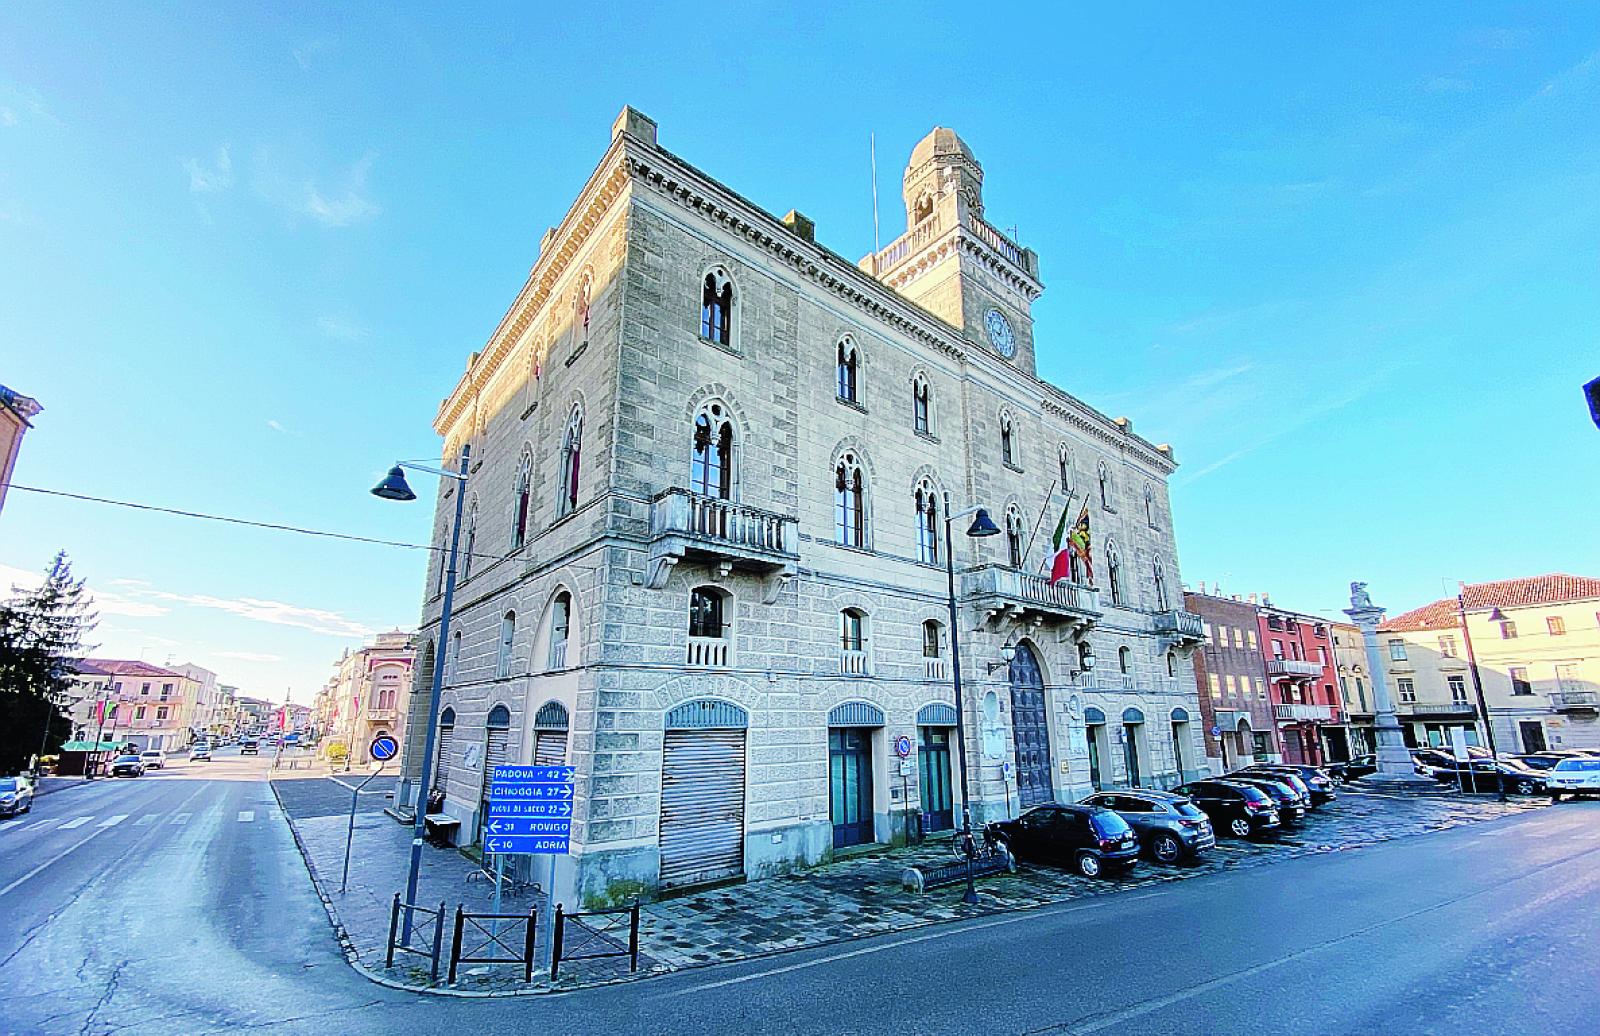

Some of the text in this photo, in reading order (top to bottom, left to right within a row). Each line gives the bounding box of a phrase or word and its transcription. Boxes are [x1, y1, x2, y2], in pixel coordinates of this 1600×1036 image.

[495, 769, 560, 779] PADOVA 42
[494, 787, 560, 796] CHIOGGIA 27
[548, 804, 558, 814] 22
[503, 822, 569, 832] 31 ROVIGO
[502, 840, 567, 850] 10 ADRIA
